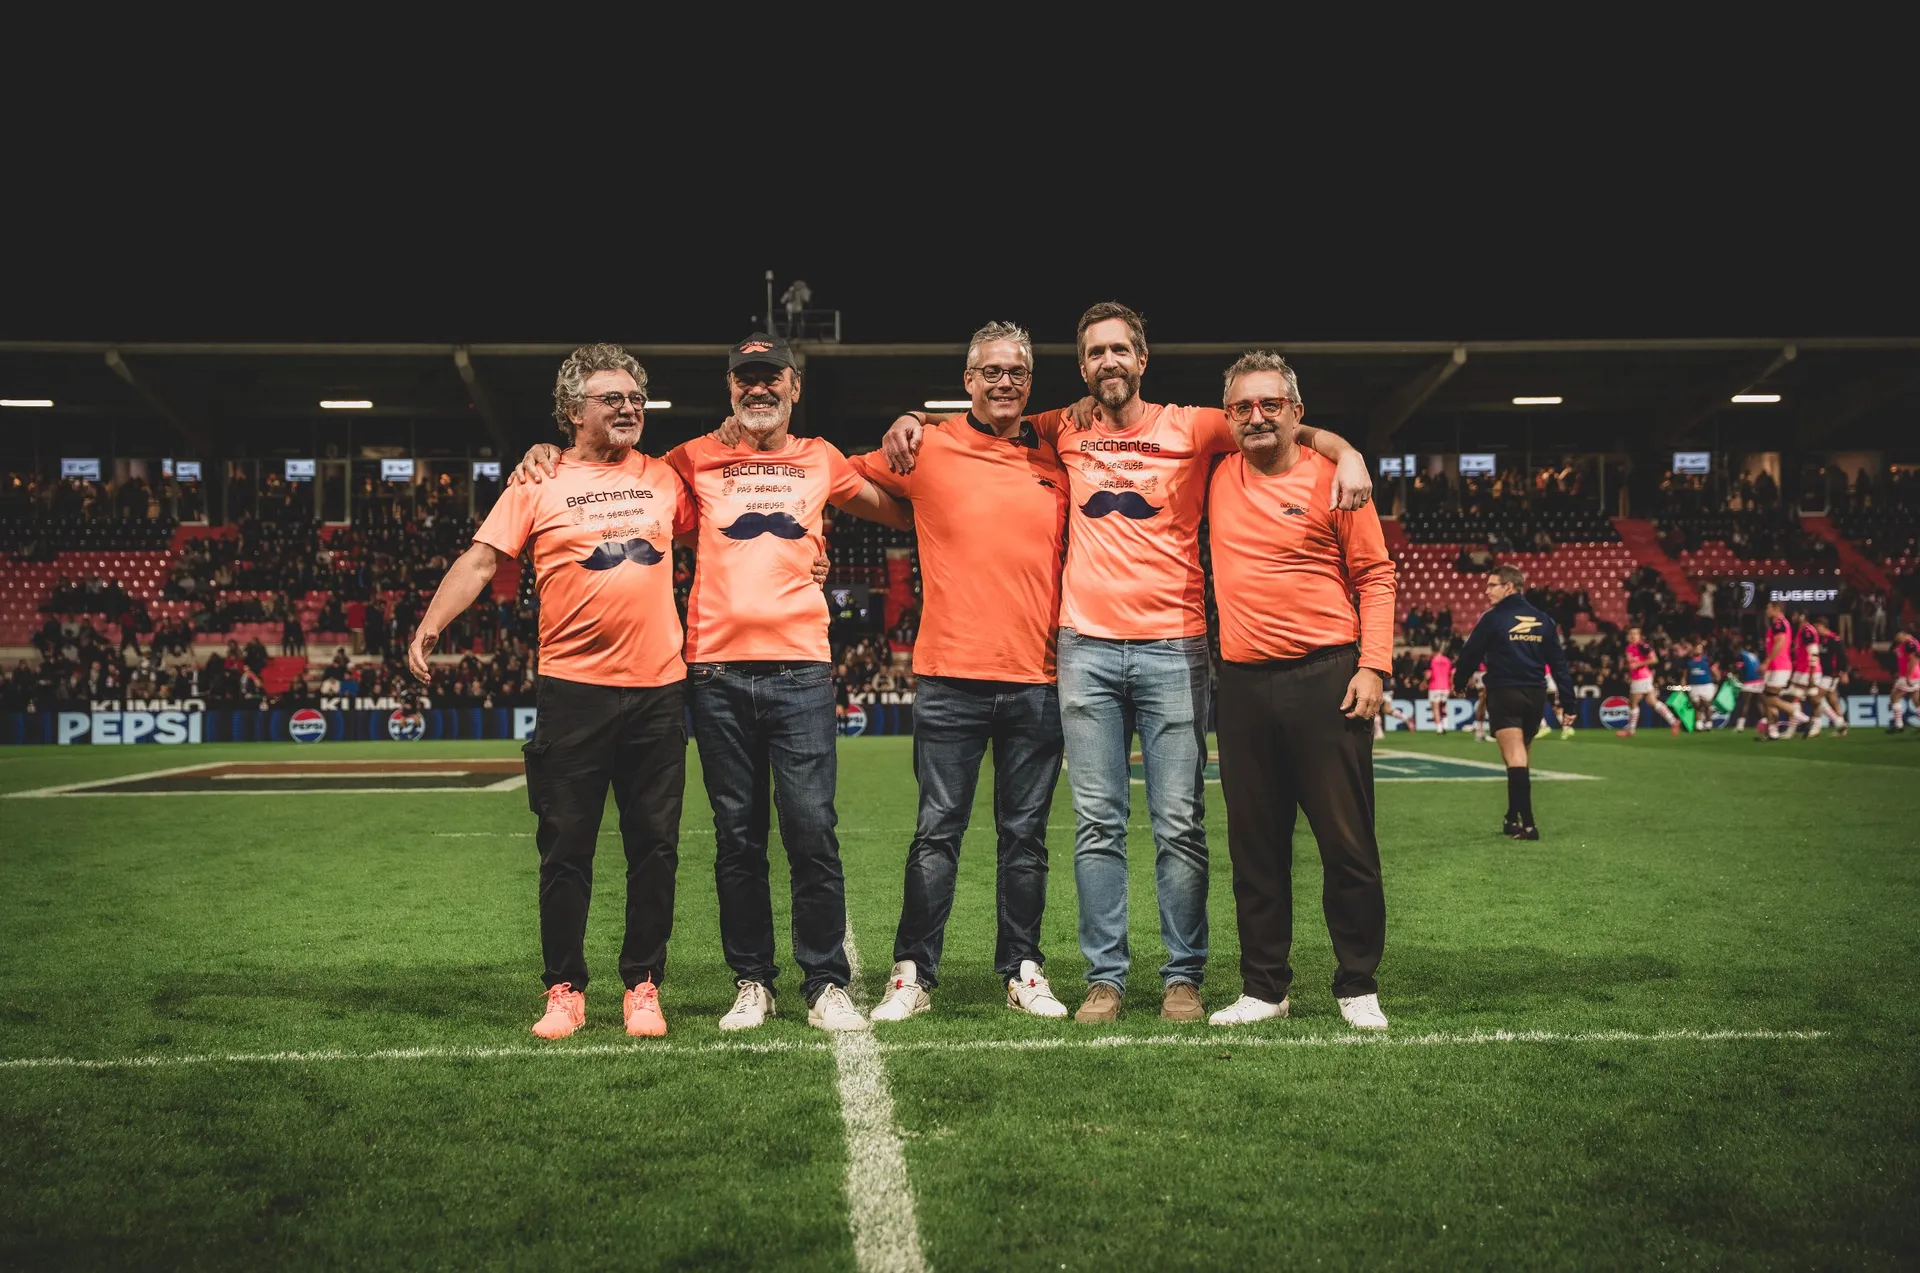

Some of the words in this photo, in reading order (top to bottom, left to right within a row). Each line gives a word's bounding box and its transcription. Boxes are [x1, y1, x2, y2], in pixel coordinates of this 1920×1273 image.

[1080, 439, 1160, 453] Bacchantes
[722, 463, 805, 478] Bacchantes
[737, 485, 752, 493] PAS
[566, 488, 654, 508] Bacchantes
[589, 513, 605, 521] PAS
[848, 692, 916, 705] KUM
[58, 711, 203, 746] PEPSI
[293, 722, 323, 730] PEPSI
